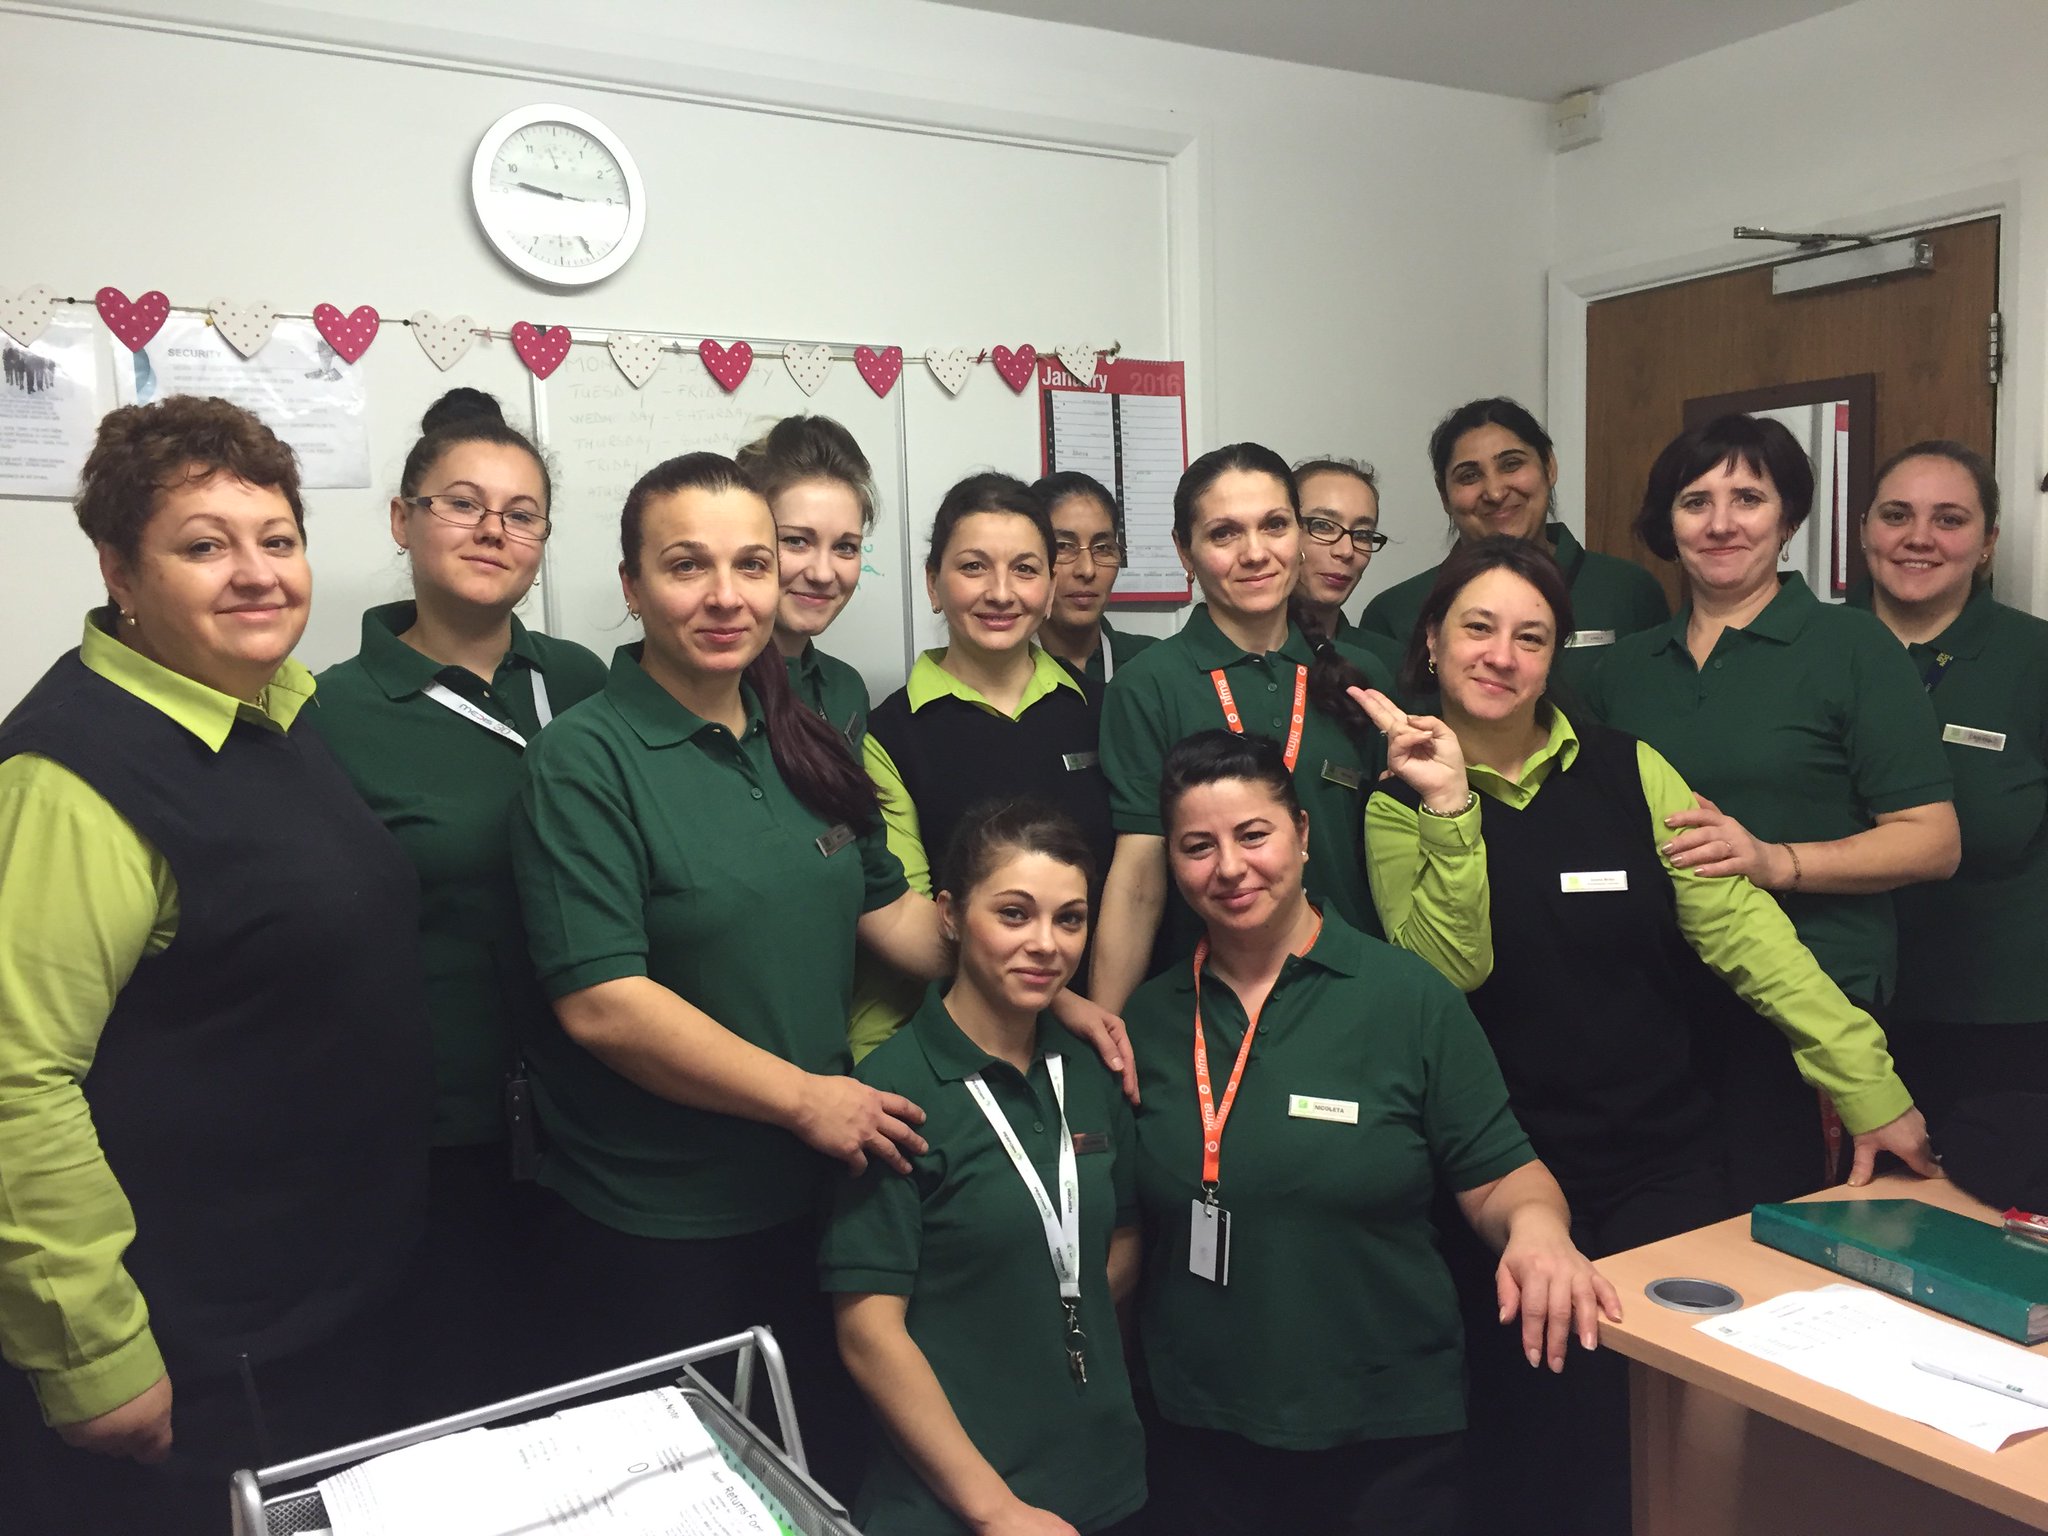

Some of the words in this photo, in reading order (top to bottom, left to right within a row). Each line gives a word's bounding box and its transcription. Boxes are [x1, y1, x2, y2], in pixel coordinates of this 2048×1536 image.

[525, 144, 534, 154] 11
[578, 151, 583, 159] 1
[507, 162, 518, 174] 10
[596, 169, 604, 180] 2
[167, 347, 221, 359] SECURITY
[1041, 366, 1109, 393] Janry
[1129, 371, 1181, 395] 2016
[568, 383, 644, 409] TUESDY
[568, 411, 656, 430] WEDNDAY
[1314, 1104, 1345, 1114] NICOLETA
[664, 1403, 680, 1420] Note
[723, 1486, 749, 1516] Returns
